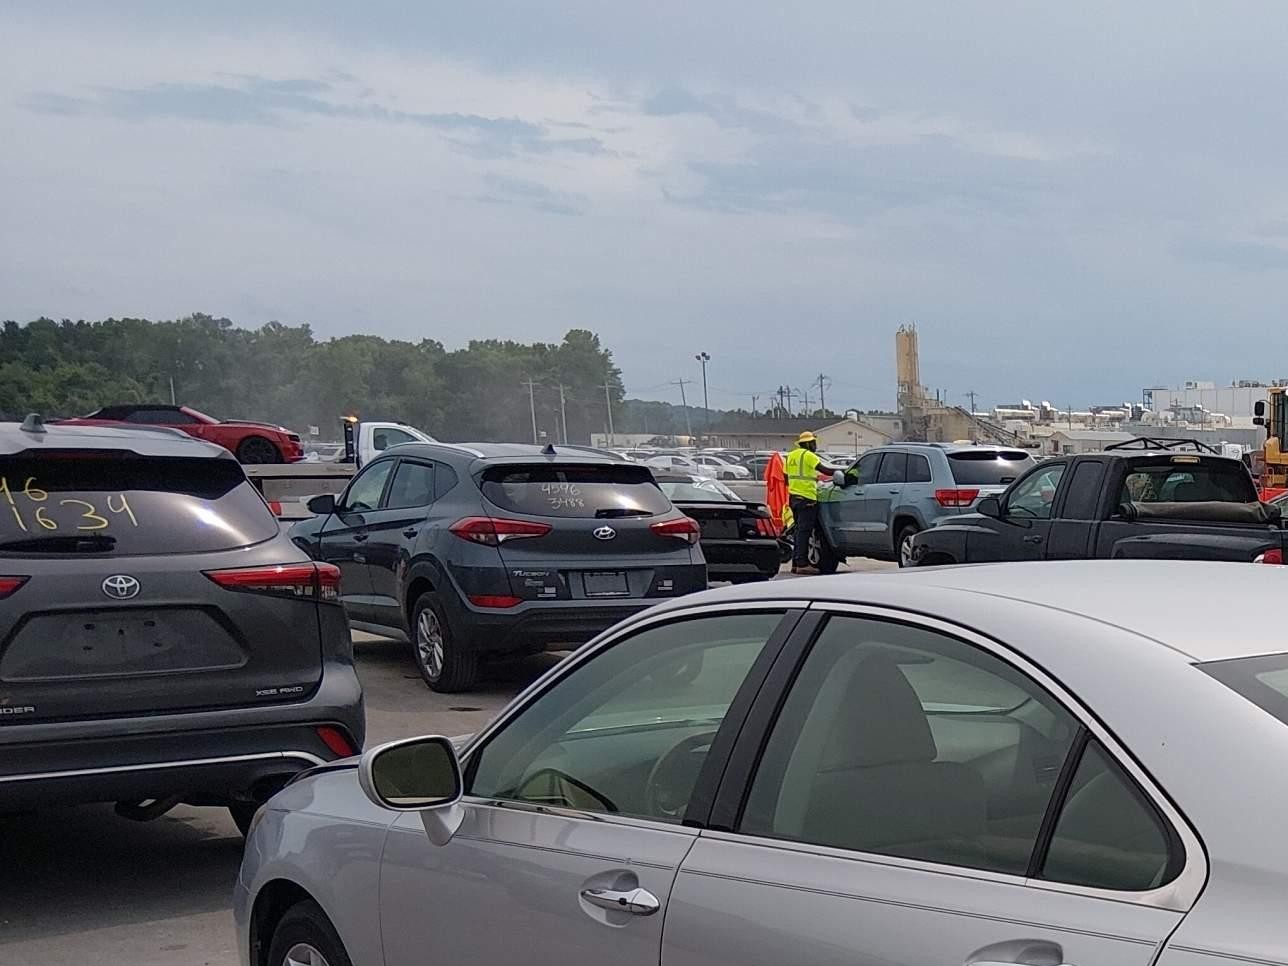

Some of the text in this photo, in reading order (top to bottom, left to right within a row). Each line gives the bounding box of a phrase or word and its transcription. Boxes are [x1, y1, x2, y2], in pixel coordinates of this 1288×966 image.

[11, 493, 138, 532] 1634
[255, 686, 304, 697] XSE AWD
[0, 706, 36, 714] DER
